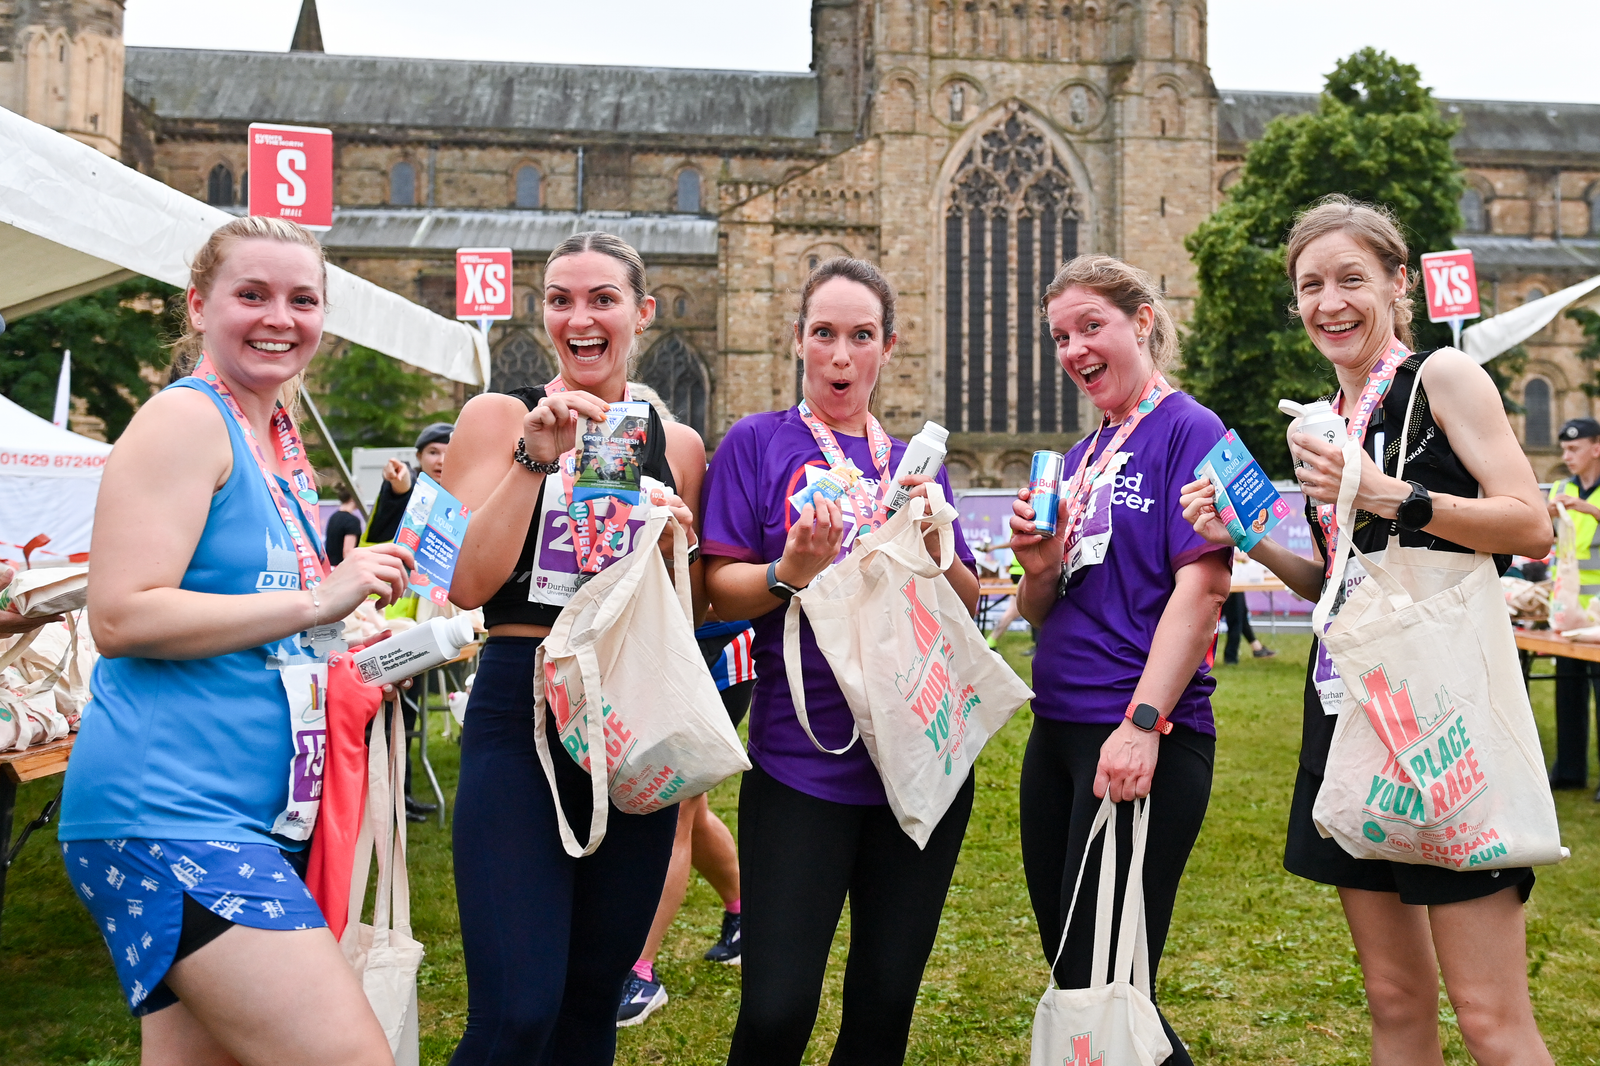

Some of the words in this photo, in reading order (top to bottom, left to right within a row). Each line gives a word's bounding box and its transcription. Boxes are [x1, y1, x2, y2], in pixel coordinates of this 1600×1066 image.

[276, 148, 306, 206] S
[280, 208, 302, 217] SMALL
[464, 264, 505, 304] XS
[1430, 264, 1472, 308] XS
[1350, 380, 1383, 438] FINISHER
[584, 434, 610, 442] SPORTS
[610, 437, 640, 445] REFRESH
[812, 422, 843, 464] FINISHER
[0, 452, 49, 466] 01429
[1039, 478, 1057, 490] Bull
[854, 494, 868, 516] 10K
[432, 513, 454, 532] LIQUID
[574, 502, 590, 557] NISHER
[602, 521, 619, 547] 10K
[281, 507, 316, 578] FINISHER
[548, 582, 576, 592] Durham
[381, 658, 394, 666] Save
[1410, 715, 1470, 788] PLACE
[626, 766, 674, 808] DURHAM
[639, 798, 662, 814] CITY
[658, 776, 686, 800] RUN
[1430, 747, 1484, 818] RACE
[1390, 838, 1412, 850] 10K
[1421, 828, 1500, 857] DURHAM
[1422, 852, 1464, 868] CITY
[1468, 843, 1508, 866] RUN
